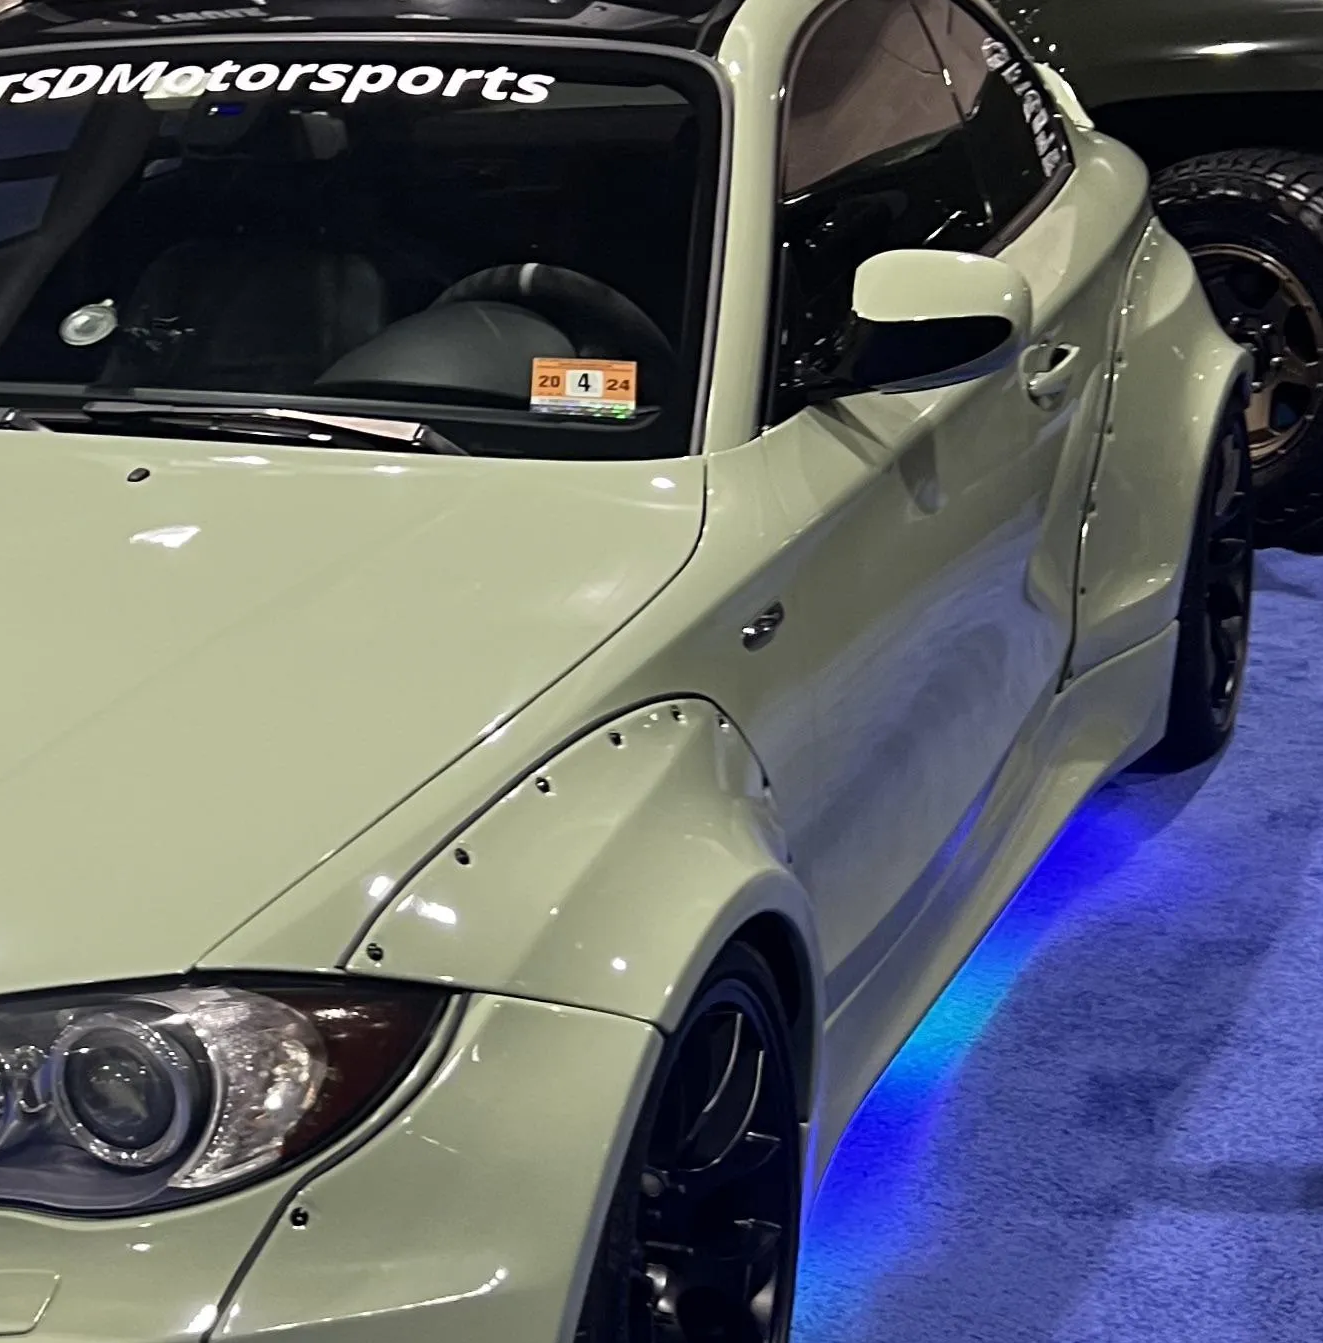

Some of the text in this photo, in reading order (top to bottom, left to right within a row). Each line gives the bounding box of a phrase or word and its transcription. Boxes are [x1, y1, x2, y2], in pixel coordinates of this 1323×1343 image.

[538, 373, 630, 392] 20 4 24
